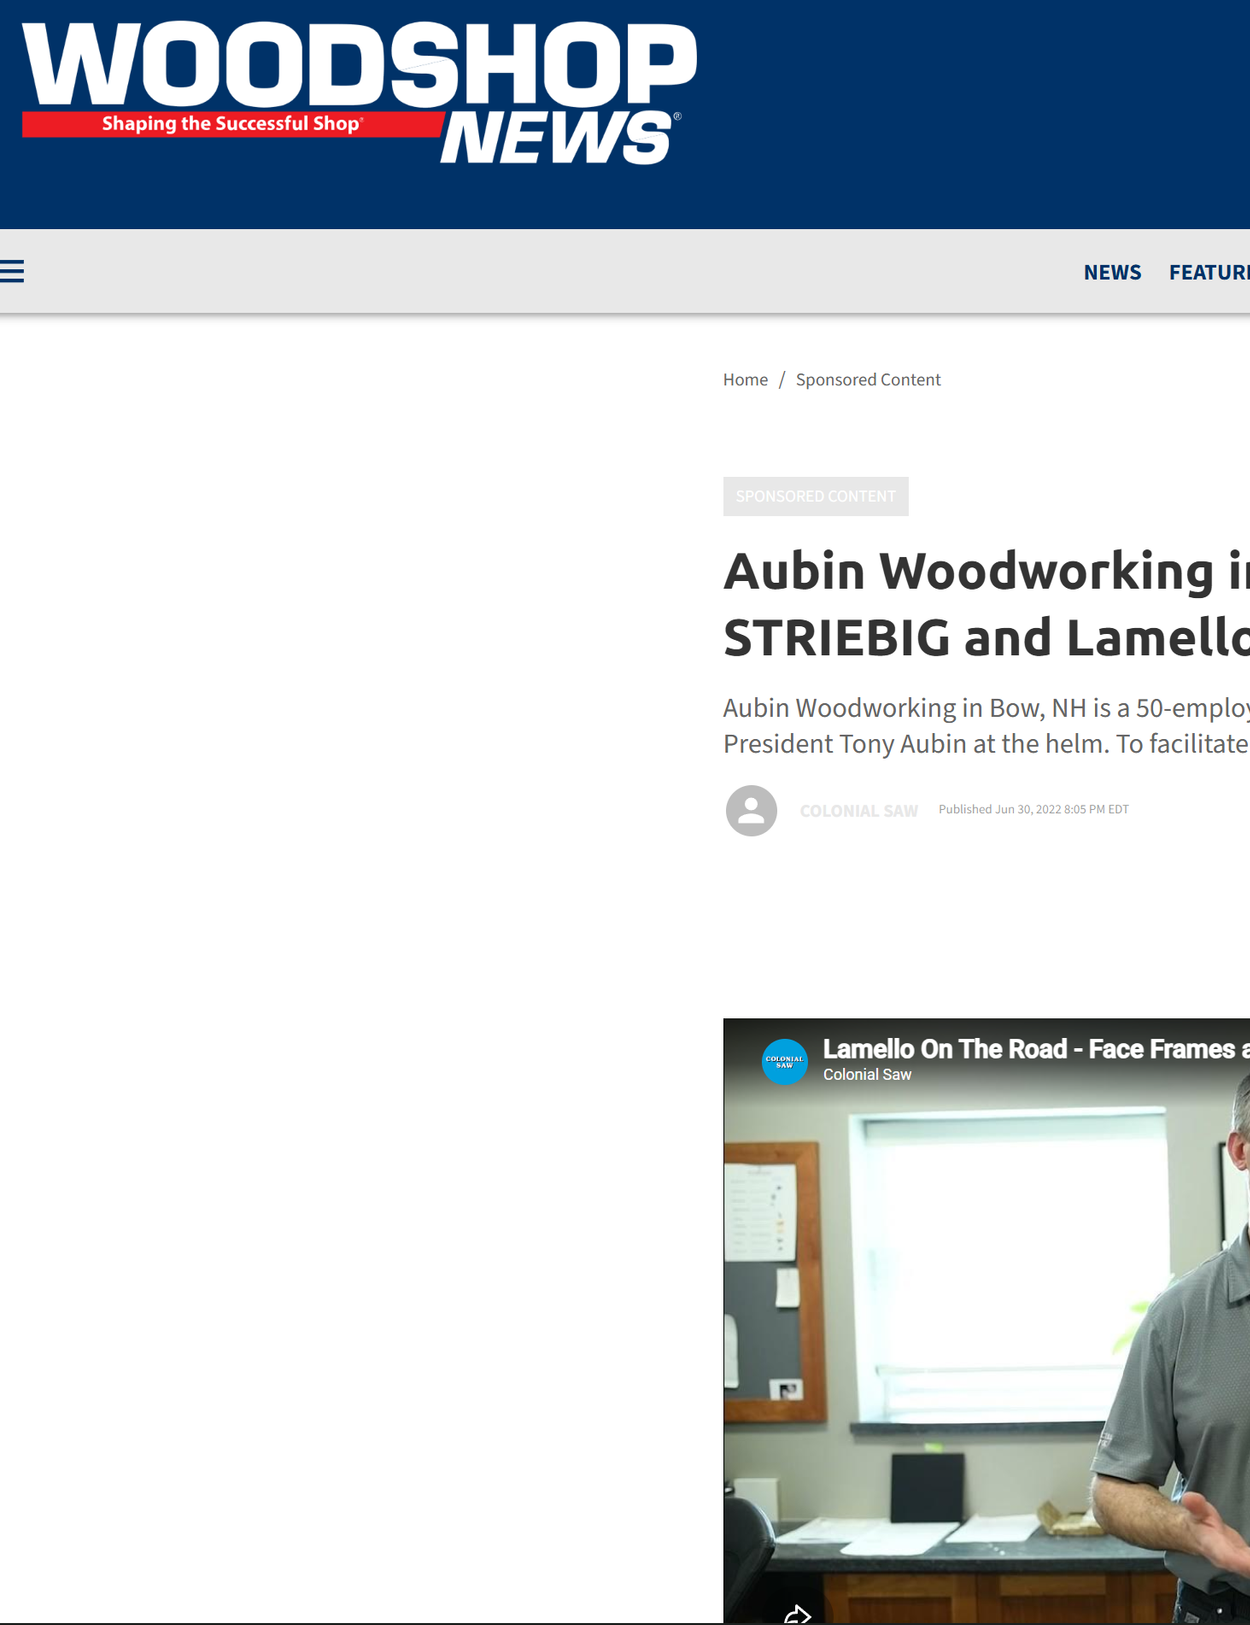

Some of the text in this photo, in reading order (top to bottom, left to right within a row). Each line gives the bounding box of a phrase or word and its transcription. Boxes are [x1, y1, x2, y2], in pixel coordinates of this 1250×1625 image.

[21, 20, 698, 109] WOODSHOP
[102, 115, 177, 135] Shaping
[180, 115, 212, 131] the
[215, 115, 309, 131] Successful
[1084, 263, 1142, 281] NEWS
[723, 372, 769, 387] Home
[796, 371, 877, 390] Sponsored
[880, 372, 942, 387] Content
[735, 489, 897, 503] SPONSORED CONTENT
[723, 548, 864, 591] Aubin
[879, 548, 1213, 599] Woodworking
[724, 618, 949, 657] STRIEBIG
[964, 615, 1051, 657] and
[722, 696, 789, 718] Aubin
[795, 696, 957, 724] Woodworking
[962, 697, 983, 718] in
[990, 698, 1046, 722] Bow,
[1052, 698, 1086, 718] NH
[1093, 697, 1112, 718] is
[1117, 702, 1130, 718] a
[724, 732, 834, 754] President
[838, 734, 896, 760] Tony
[899, 732, 967, 754] Aubin
[973, 734, 997, 754] at
[1001, 732, 1040, 754] the
[1046, 732, 1110, 754] helm.
[1115, 734, 1144, 754] To
[1149, 732, 1249, 754] facilitate
[799, 804, 919, 818] COLONIAL SAW
[938, 803, 1130, 816] Published Jun 30, 2022 8:05 PM EDT
[824, 1037, 915, 1059] Lamello
[921, 1038, 953, 1059] On
[958, 1037, 1003, 1059] The
[1009, 1037, 1068, 1059] Road
[1089, 1038, 1145, 1059] Face
[1150, 1038, 1236, 1059] Frames
[823, 1067, 912, 1081] Colonial Saw
